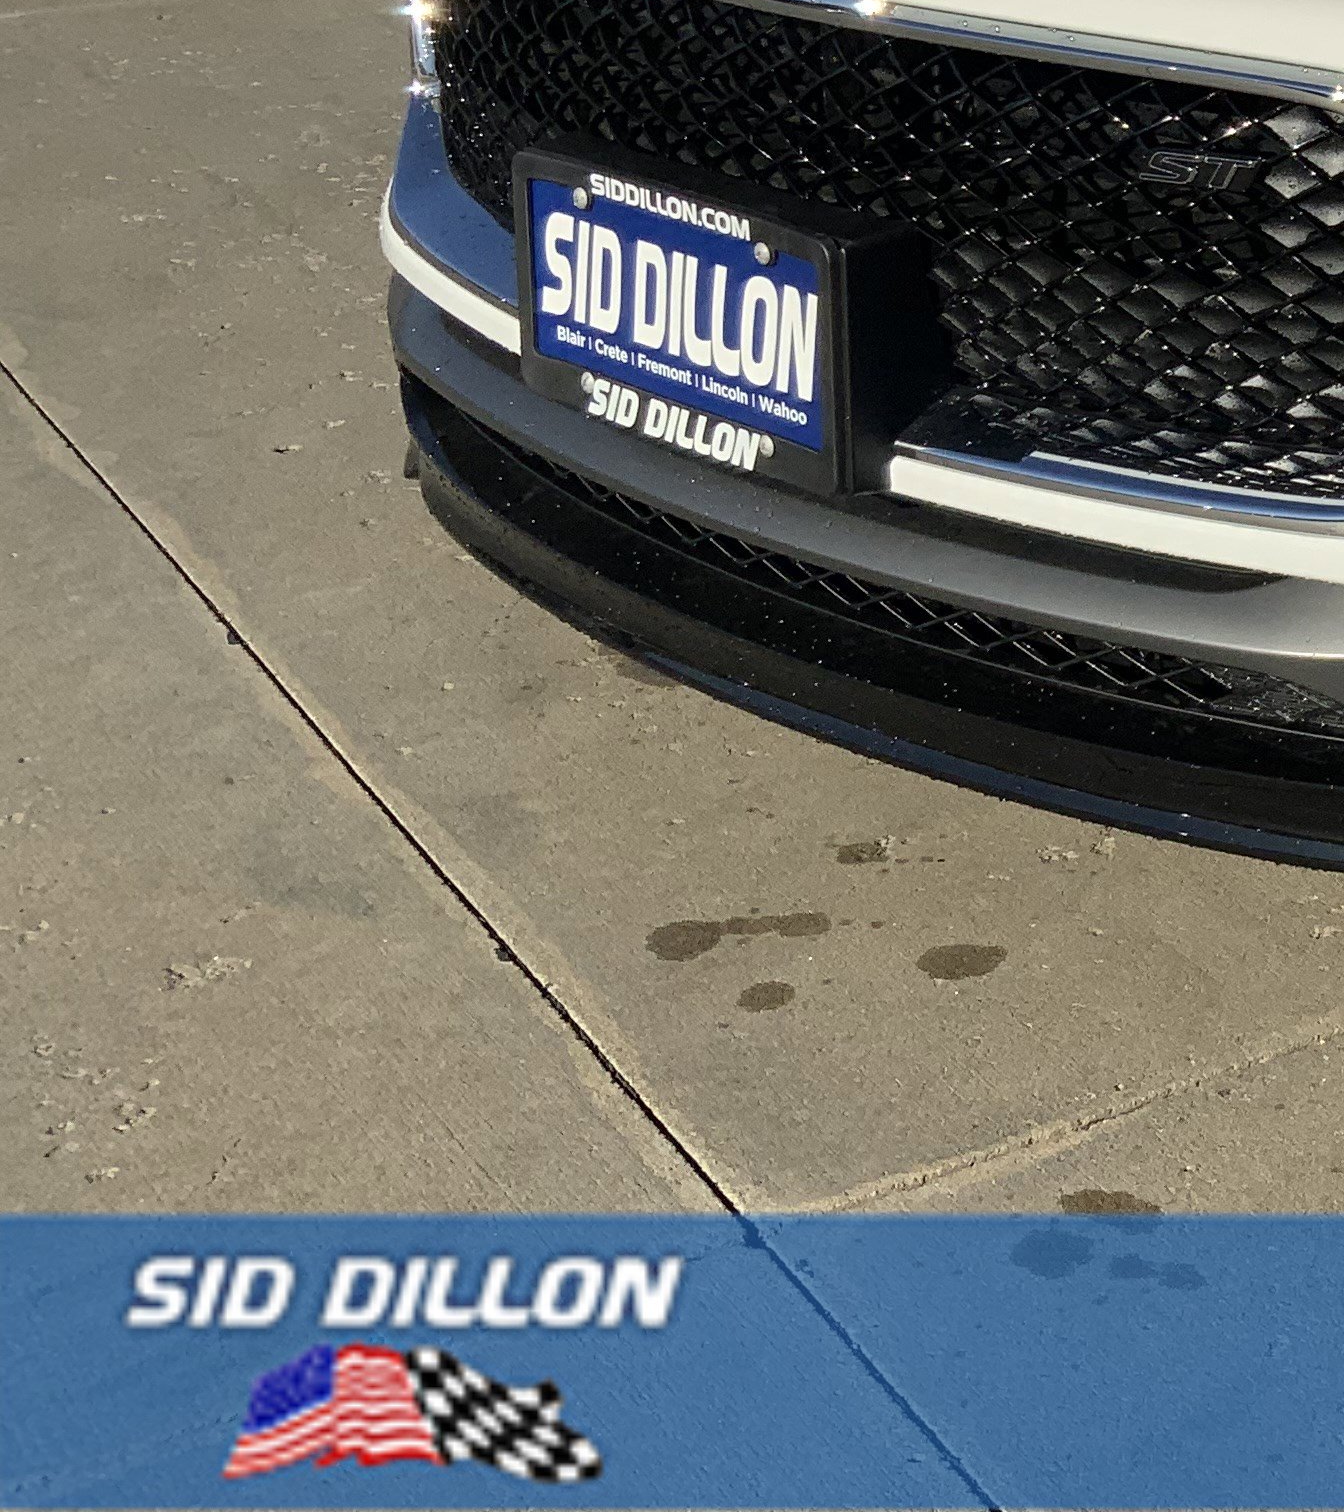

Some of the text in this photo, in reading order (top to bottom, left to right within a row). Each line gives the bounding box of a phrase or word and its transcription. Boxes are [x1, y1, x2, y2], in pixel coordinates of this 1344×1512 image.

[589, 173, 751, 242] SIDDILLON.COM
[1138, 150, 1260, 189] ST
[541, 211, 819, 402] SID DILLON
[556, 325, 808, 426] Blair Crete Fremont Lincoln Wahoo
[587, 378, 761, 472] SID DILLON
